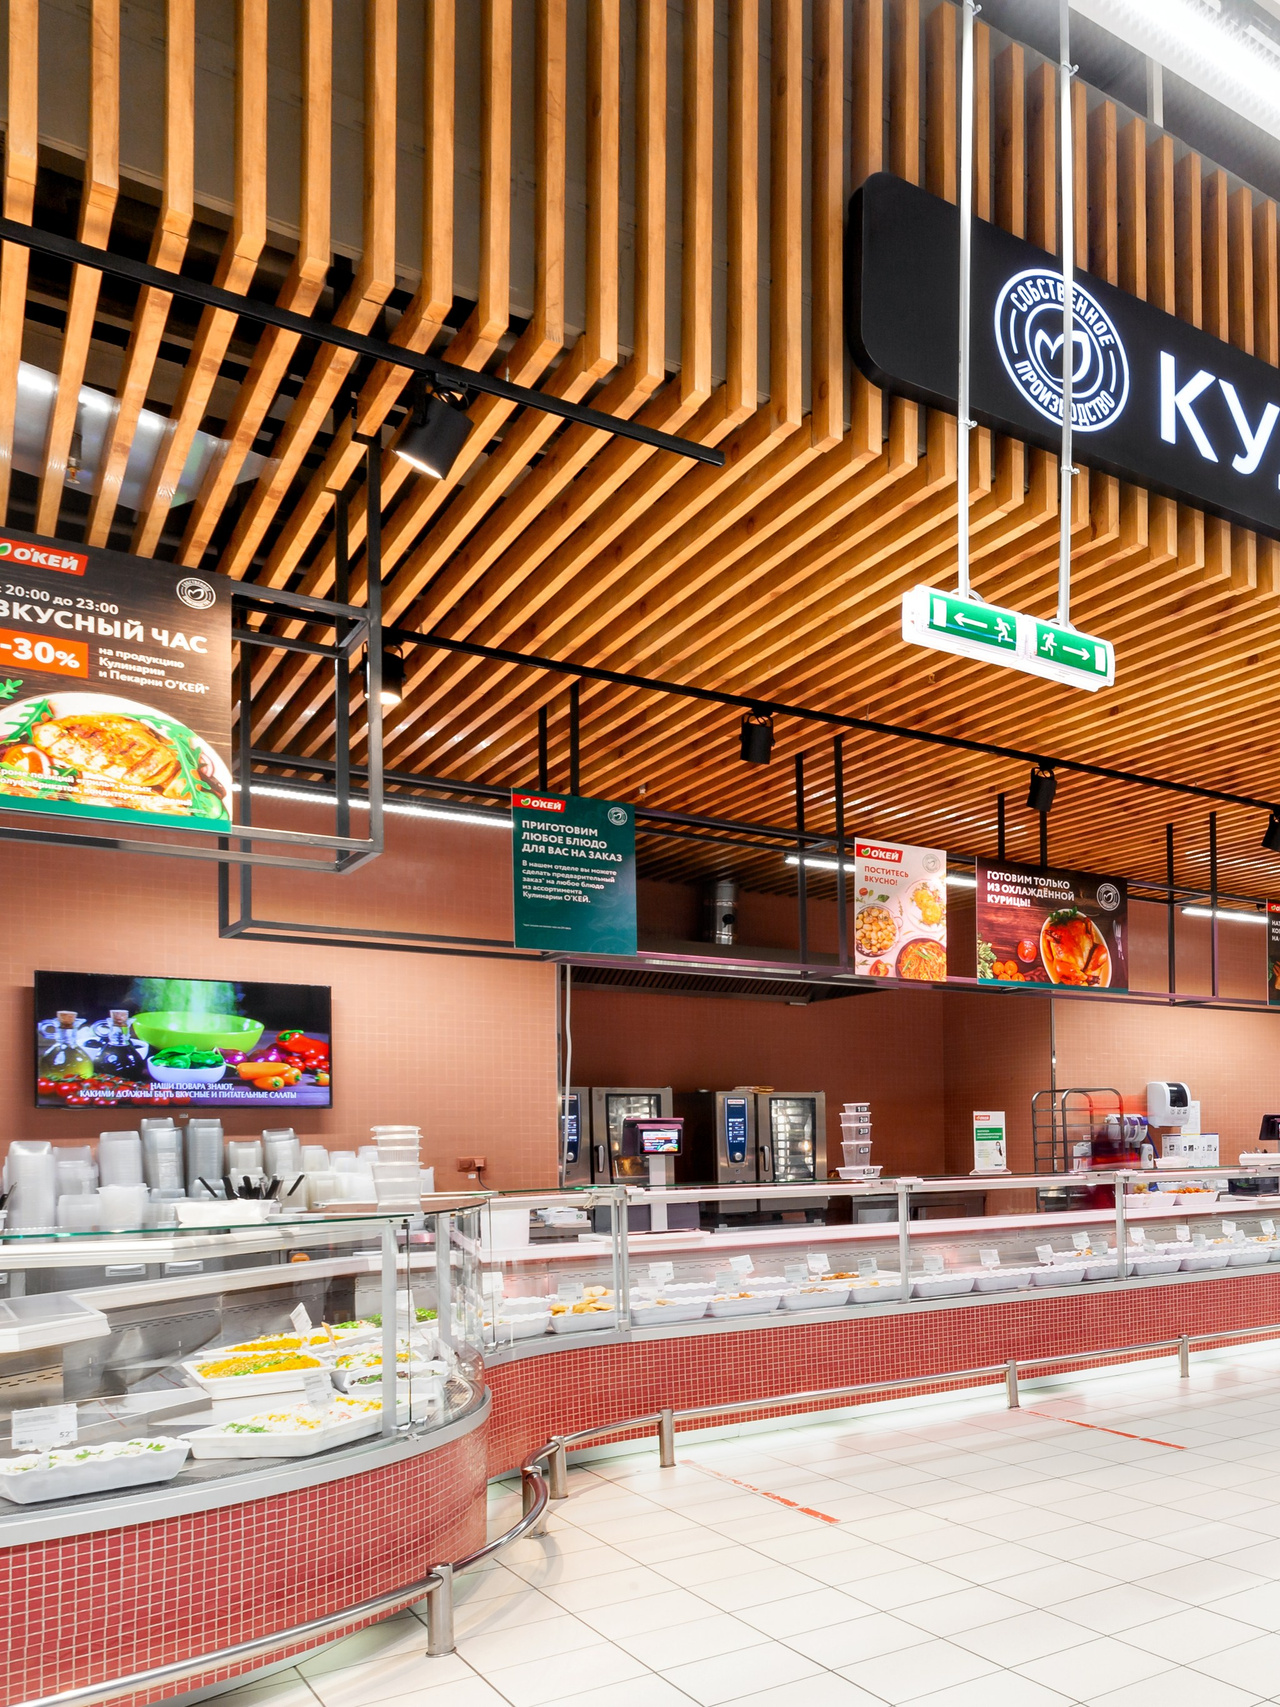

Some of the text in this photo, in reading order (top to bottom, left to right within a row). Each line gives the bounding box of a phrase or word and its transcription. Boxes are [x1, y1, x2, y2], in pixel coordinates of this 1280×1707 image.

[1010, 278, 1115, 347] СОБСТВЕННОЕ
[5, 584, 119, 615] 20:00 до 23:00
[151, 627, 209, 654] ЧАС
[0, 637, 80, 669] -30%
[98, 647, 185, 669] на продукцию
[98, 656, 165, 677] Кулинарии
[98, 670, 107, 678] и
[109, 671, 163, 688] Пекарни
[521, 820, 598, 837] ПРИГОТОВИМ
[521, 832, 608, 849] ЛЮБОЕ БЛЮДО
[521, 843, 623, 862] ДЛЯ ВАС НА ЗАКАЗ
[522, 869, 616, 883] сделать предварительный
[528, 861, 553, 869] нашем
[554, 864, 579, 872] отделе
[591, 868, 617, 876] можете
[864, 866, 909, 878] ПОСТИТЕСЬ
[580, 881, 605, 890] блюдо
[864, 876, 898, 886] ВКУСНО!
[986, 870, 1070, 890] ГОТОВИМ ТОЛЬКО
[522, 891, 563, 901] Кулинарии
[532, 885, 583, 895] ассортимента
[986, 882, 1075, 902] ИЗ ОХЛАЖДЁННОЙ
[986, 892, 1031, 908] КУРИЦЫ!
[80, 1090, 115, 1098] КАКИМИ
[116, 1090, 153, 1098] ДОЛЖНЫ
[154, 1090, 174, 1098] БЫТЬ
[175, 1091, 209, 1099] ВКУСНЫЕ
[211, 1091, 218, 1099] И
[218, 1091, 268, 1099] ПИТАТЕЛЬНЫЕ
[151, 1083, 235, 1092] НАШИ ПОВАРА ЗНАЮТ,
